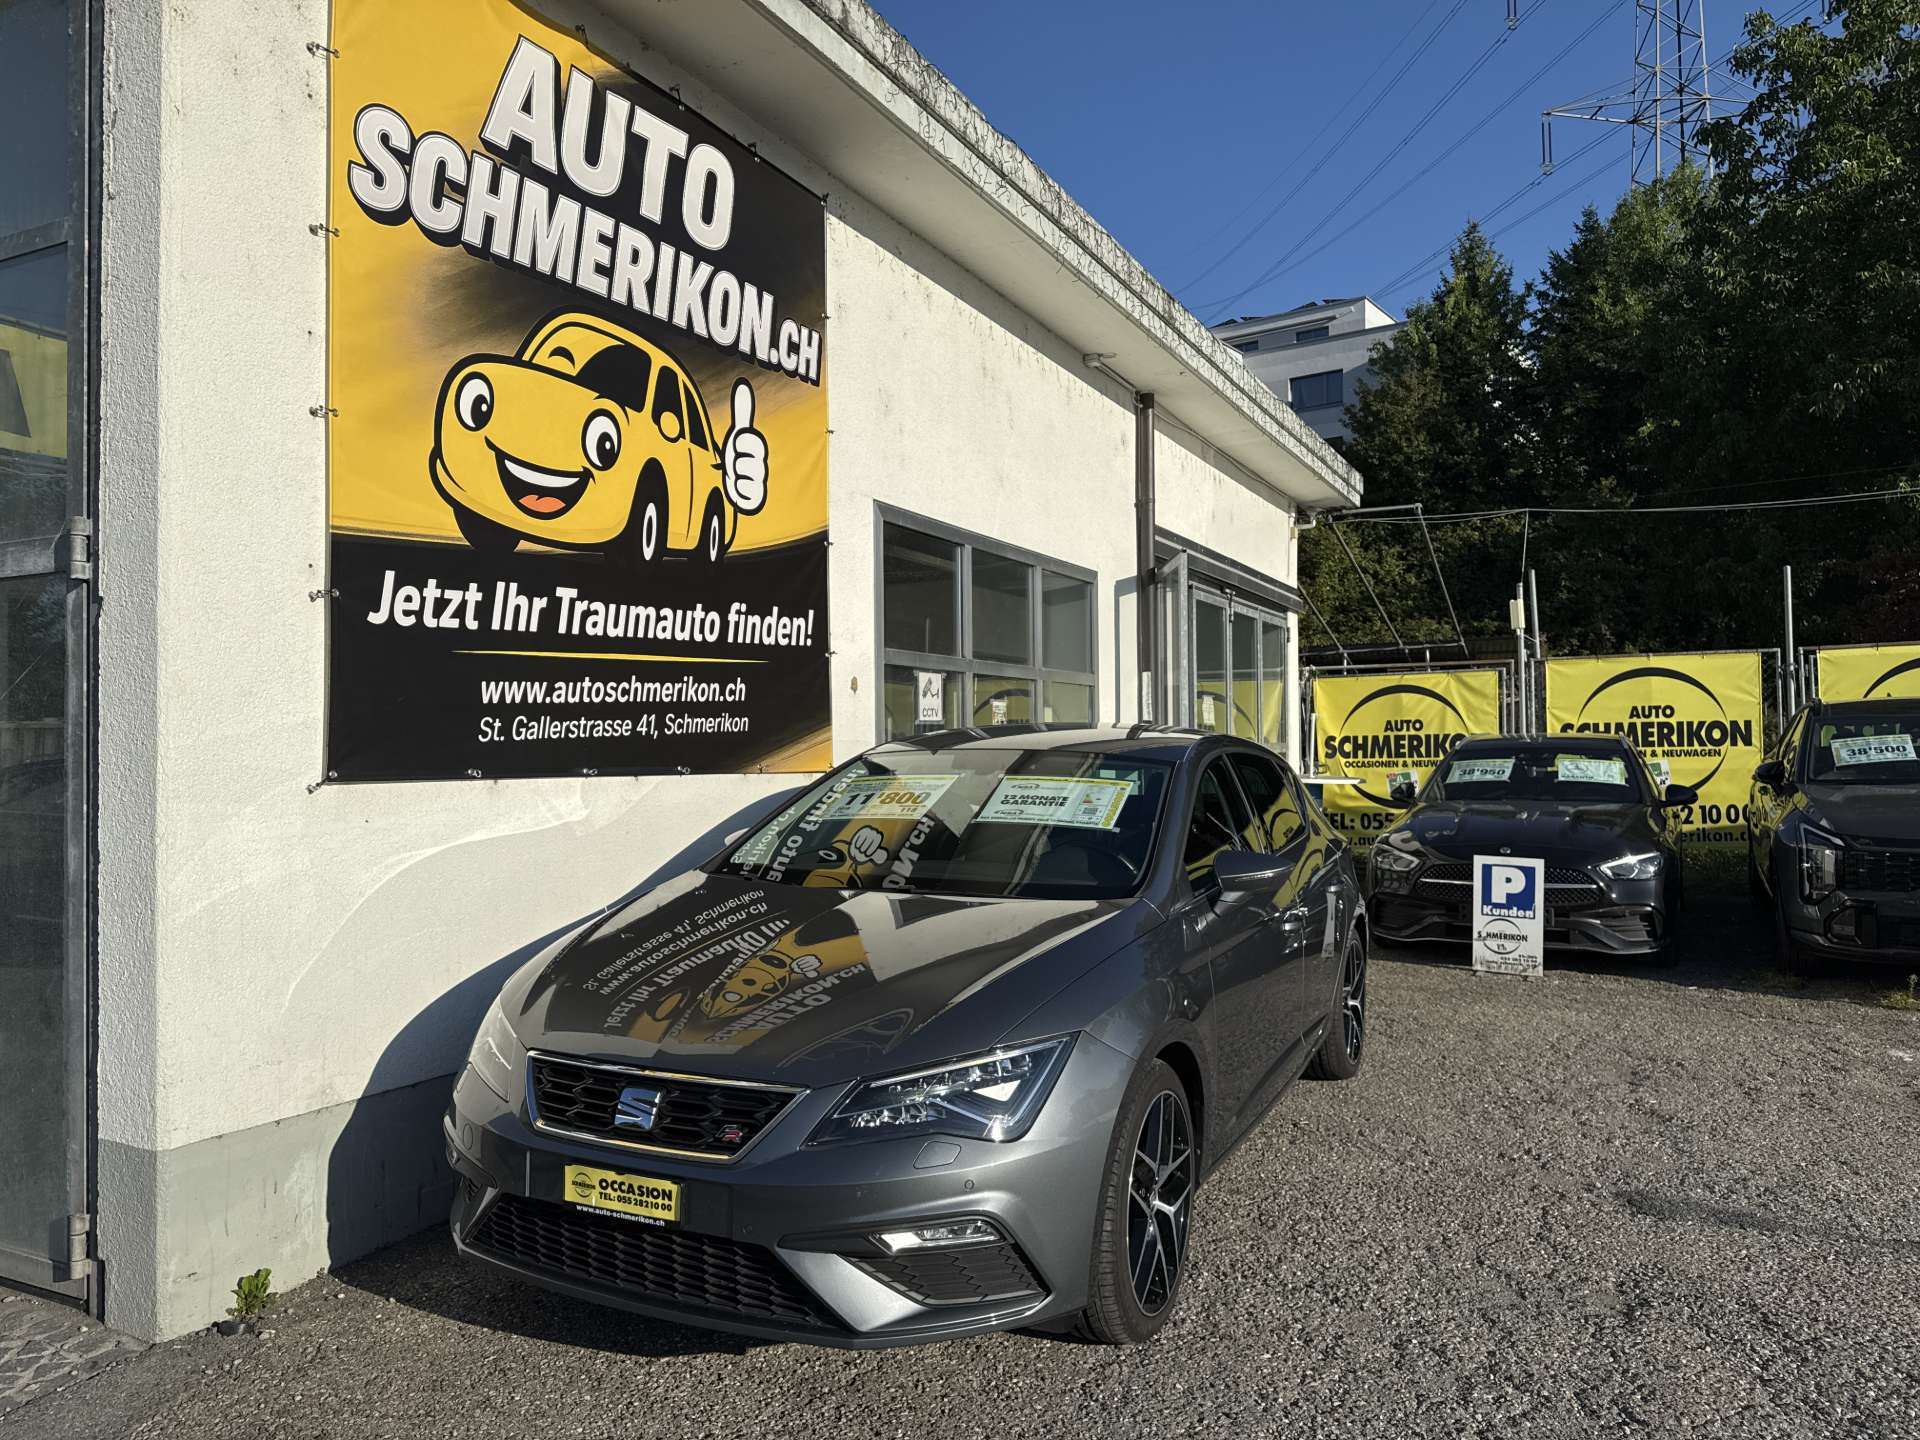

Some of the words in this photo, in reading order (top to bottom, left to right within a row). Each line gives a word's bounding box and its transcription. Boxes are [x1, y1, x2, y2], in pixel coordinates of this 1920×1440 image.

[481, 35, 735, 250] AUTO
[349, 106, 821, 381] SCHMERIKON.CH
[367, 570, 483, 630] Jetzt
[491, 581, 549, 632] Ihr
[555, 587, 721, 644] Traumauto
[727, 602, 814, 646] finden!
[481, 676, 746, 705] www.autoschmerikon.ch
[922, 708, 939, 718] CCTV
[1629, 705, 1675, 719] AUTO
[478, 717, 505, 742] St.
[512, 713, 632, 741] Gallerstrasse
[637, 713, 659, 738] 41,
[664, 713, 749, 735] Schmerikon
[1383, 719, 1424, 732] AUTO
[1650, 749, 1658, 758] &
[1661, 749, 1721, 758] NEUWAGEN
[1846, 745, 1908, 757] 38'500
[1344, 760, 1399, 768] OCCASIONEN
[1401, 760, 1409, 768] &
[1411, 759, 1441, 768] NEUW
[1458, 768, 1506, 776] 38'950
[1000, 799, 1068, 807] GARANTIE
[1018, 794, 1071, 802] MONATE
[1699, 804, 1722, 825] 10
[1491, 865, 1527, 904] P
[1482, 904, 1535, 918] Kunden
[1477, 930, 1528, 942] SHMERIKON
[598, 1178, 673, 1202] OCCASION
[598, 1192, 616, 1202] TEL:
[616, 1195, 633, 1204] 055
[633, 1198, 649, 1208] 282
[660, 1203, 673, 1212] 00
[576, 1204, 665, 1227] www.auto-schmerikon.ch
